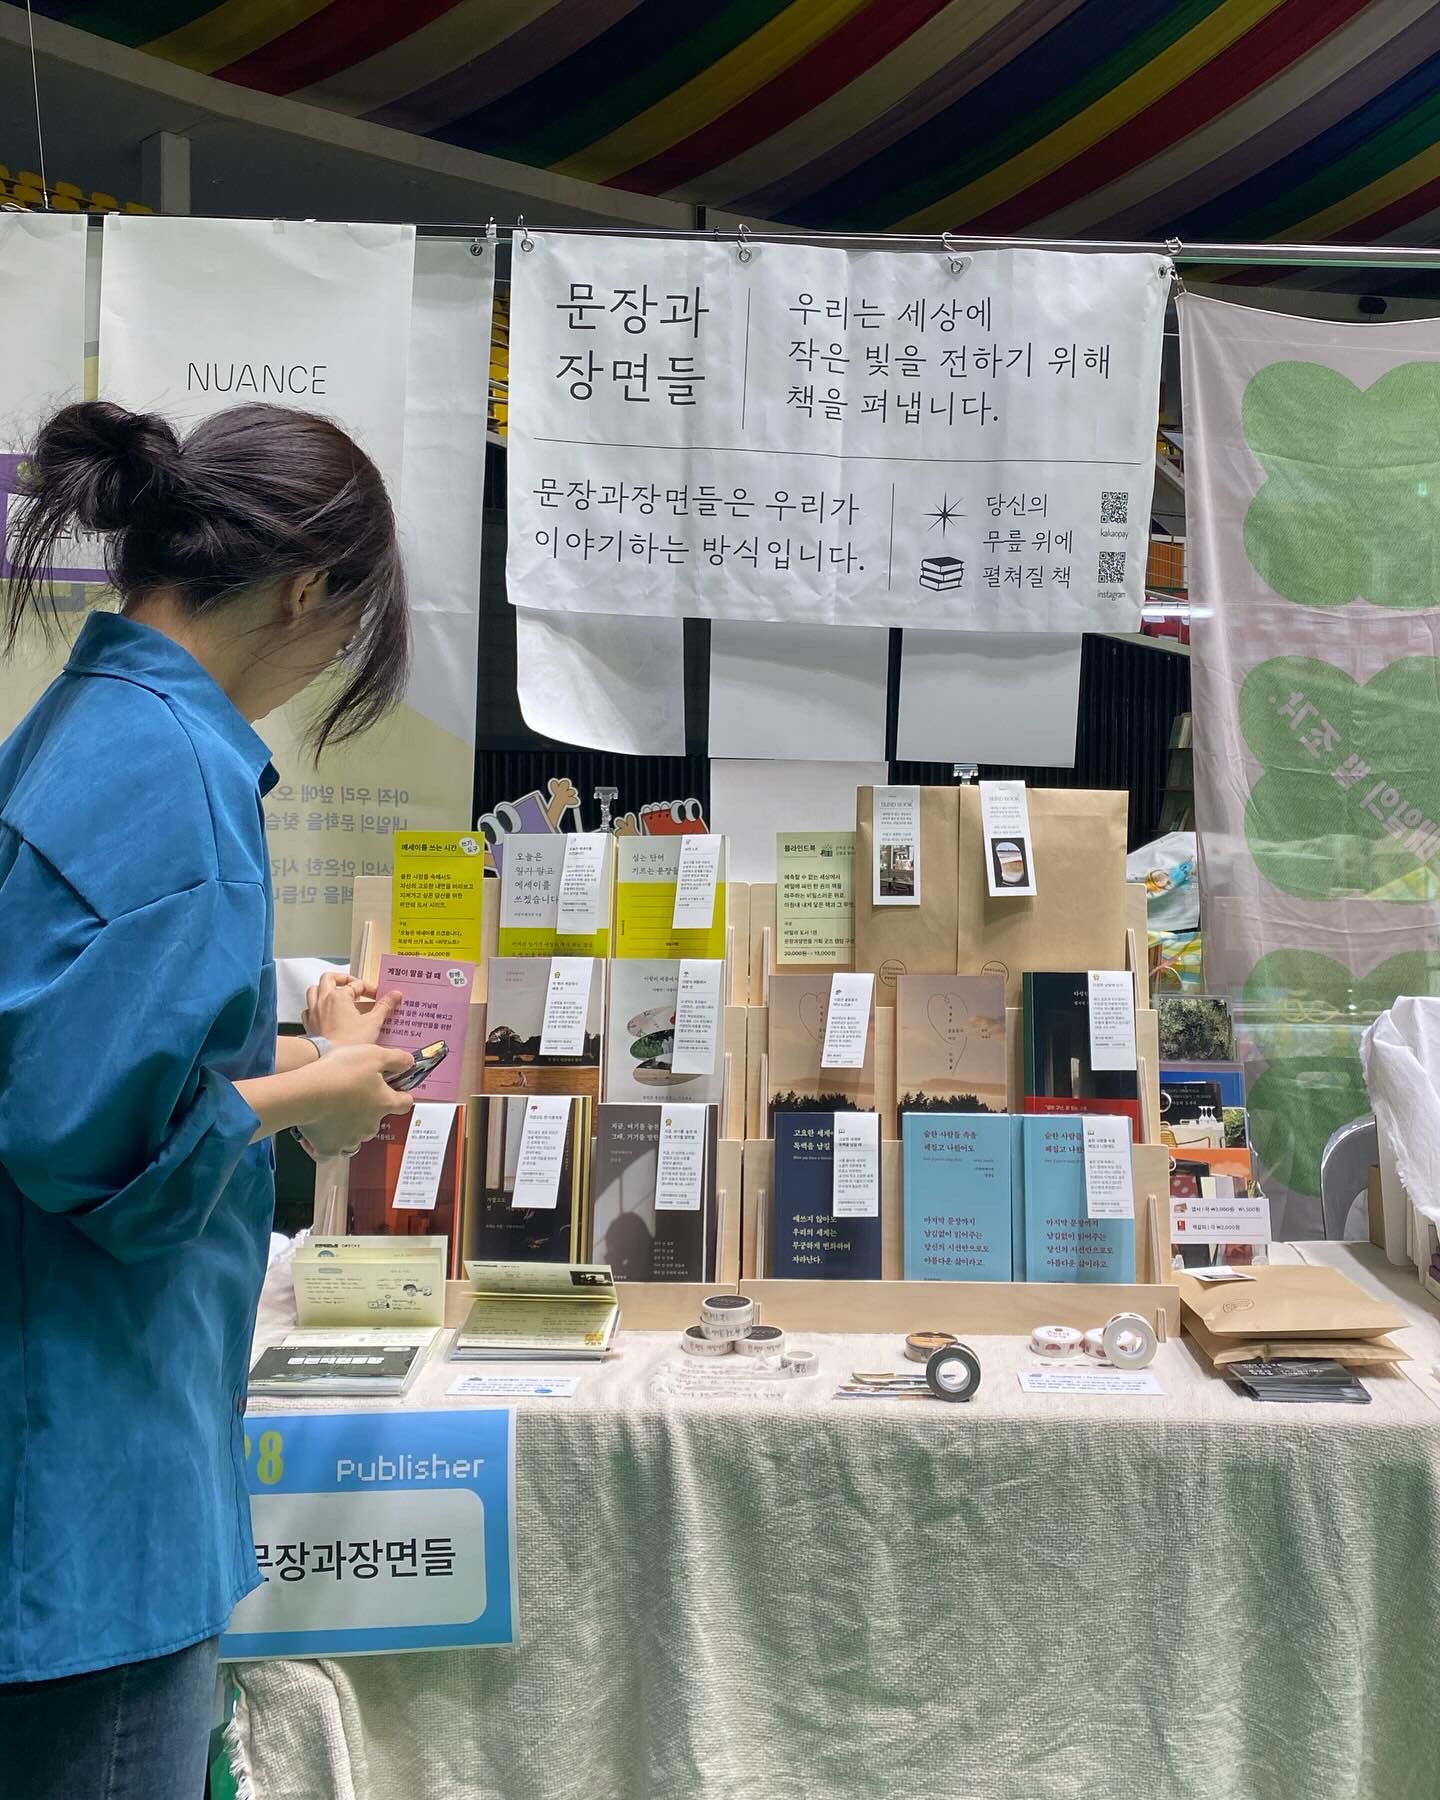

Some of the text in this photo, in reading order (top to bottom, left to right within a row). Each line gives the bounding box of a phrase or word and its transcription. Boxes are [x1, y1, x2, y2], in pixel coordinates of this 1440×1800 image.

[556, 282, 710, 338] 문장과
[788, 292, 993, 334] 우리는 세상에
[786, 337, 1110, 381] 작은 빛을 전하기 위해
[187, 362, 327, 395] NUANCE
[554, 349, 706, 406] 장면들
[785, 382, 849, 423] 책을
[532, 476, 860, 527] 문장과장면들은 우리가
[985, 492, 1048, 520] 당신의
[1100, 528, 1128, 540] kakaopay
[982, 528, 1074, 554] 무릎 위에
[533, 526, 866, 576] 이야기하는 방식입니다.
[981, 563, 1072, 590] 펼쳐질 책
[1097, 590, 1126, 601] instagram
[401, 843, 457, 852] 에세이를 쓰는 시간
[784, 844, 816, 852] 블라인드북
[515, 851, 543, 862] 오늘은
[514, 880, 551, 891] 에세이를
[387, 967, 408, 977] 계절이
[409, 968, 423, 978] 말을
[793, 1129, 814, 1137] 고요한
[923, 1130, 938, 1138] 숱한
[963, 1131, 976, 1139] 속을
[1044, 1132, 1059, 1140] 숱한
[793, 1142, 831, 1151] 독백을 남길
[792, 1215, 837, 1224] 애쓰지 않아도
[923, 1216, 976, 1226] 마지막 문장까지
[1046, 1219, 1099, 1228] 마지막 문장까지
[792, 1227, 838, 1237] 우리의 세계는
[924, 1230, 983, 1240] 남김없이 읽어주는
[1046, 1232, 1106, 1241] 남김없이 읽어주는
[791, 1241, 851, 1251] 무궁하게 변화하여
[924, 1243, 990, 1252] 당신의 시선만으로도
[1046, 1246, 1068, 1254] 당신의
[791, 1255, 823, 1265] 자라난다.
[924, 1256, 984, 1266] 아름다운 삶이라고
[1046, 1259, 1108, 1268] 아름다운 삶이라고
[336, 1453, 485, 1483] Publisher
